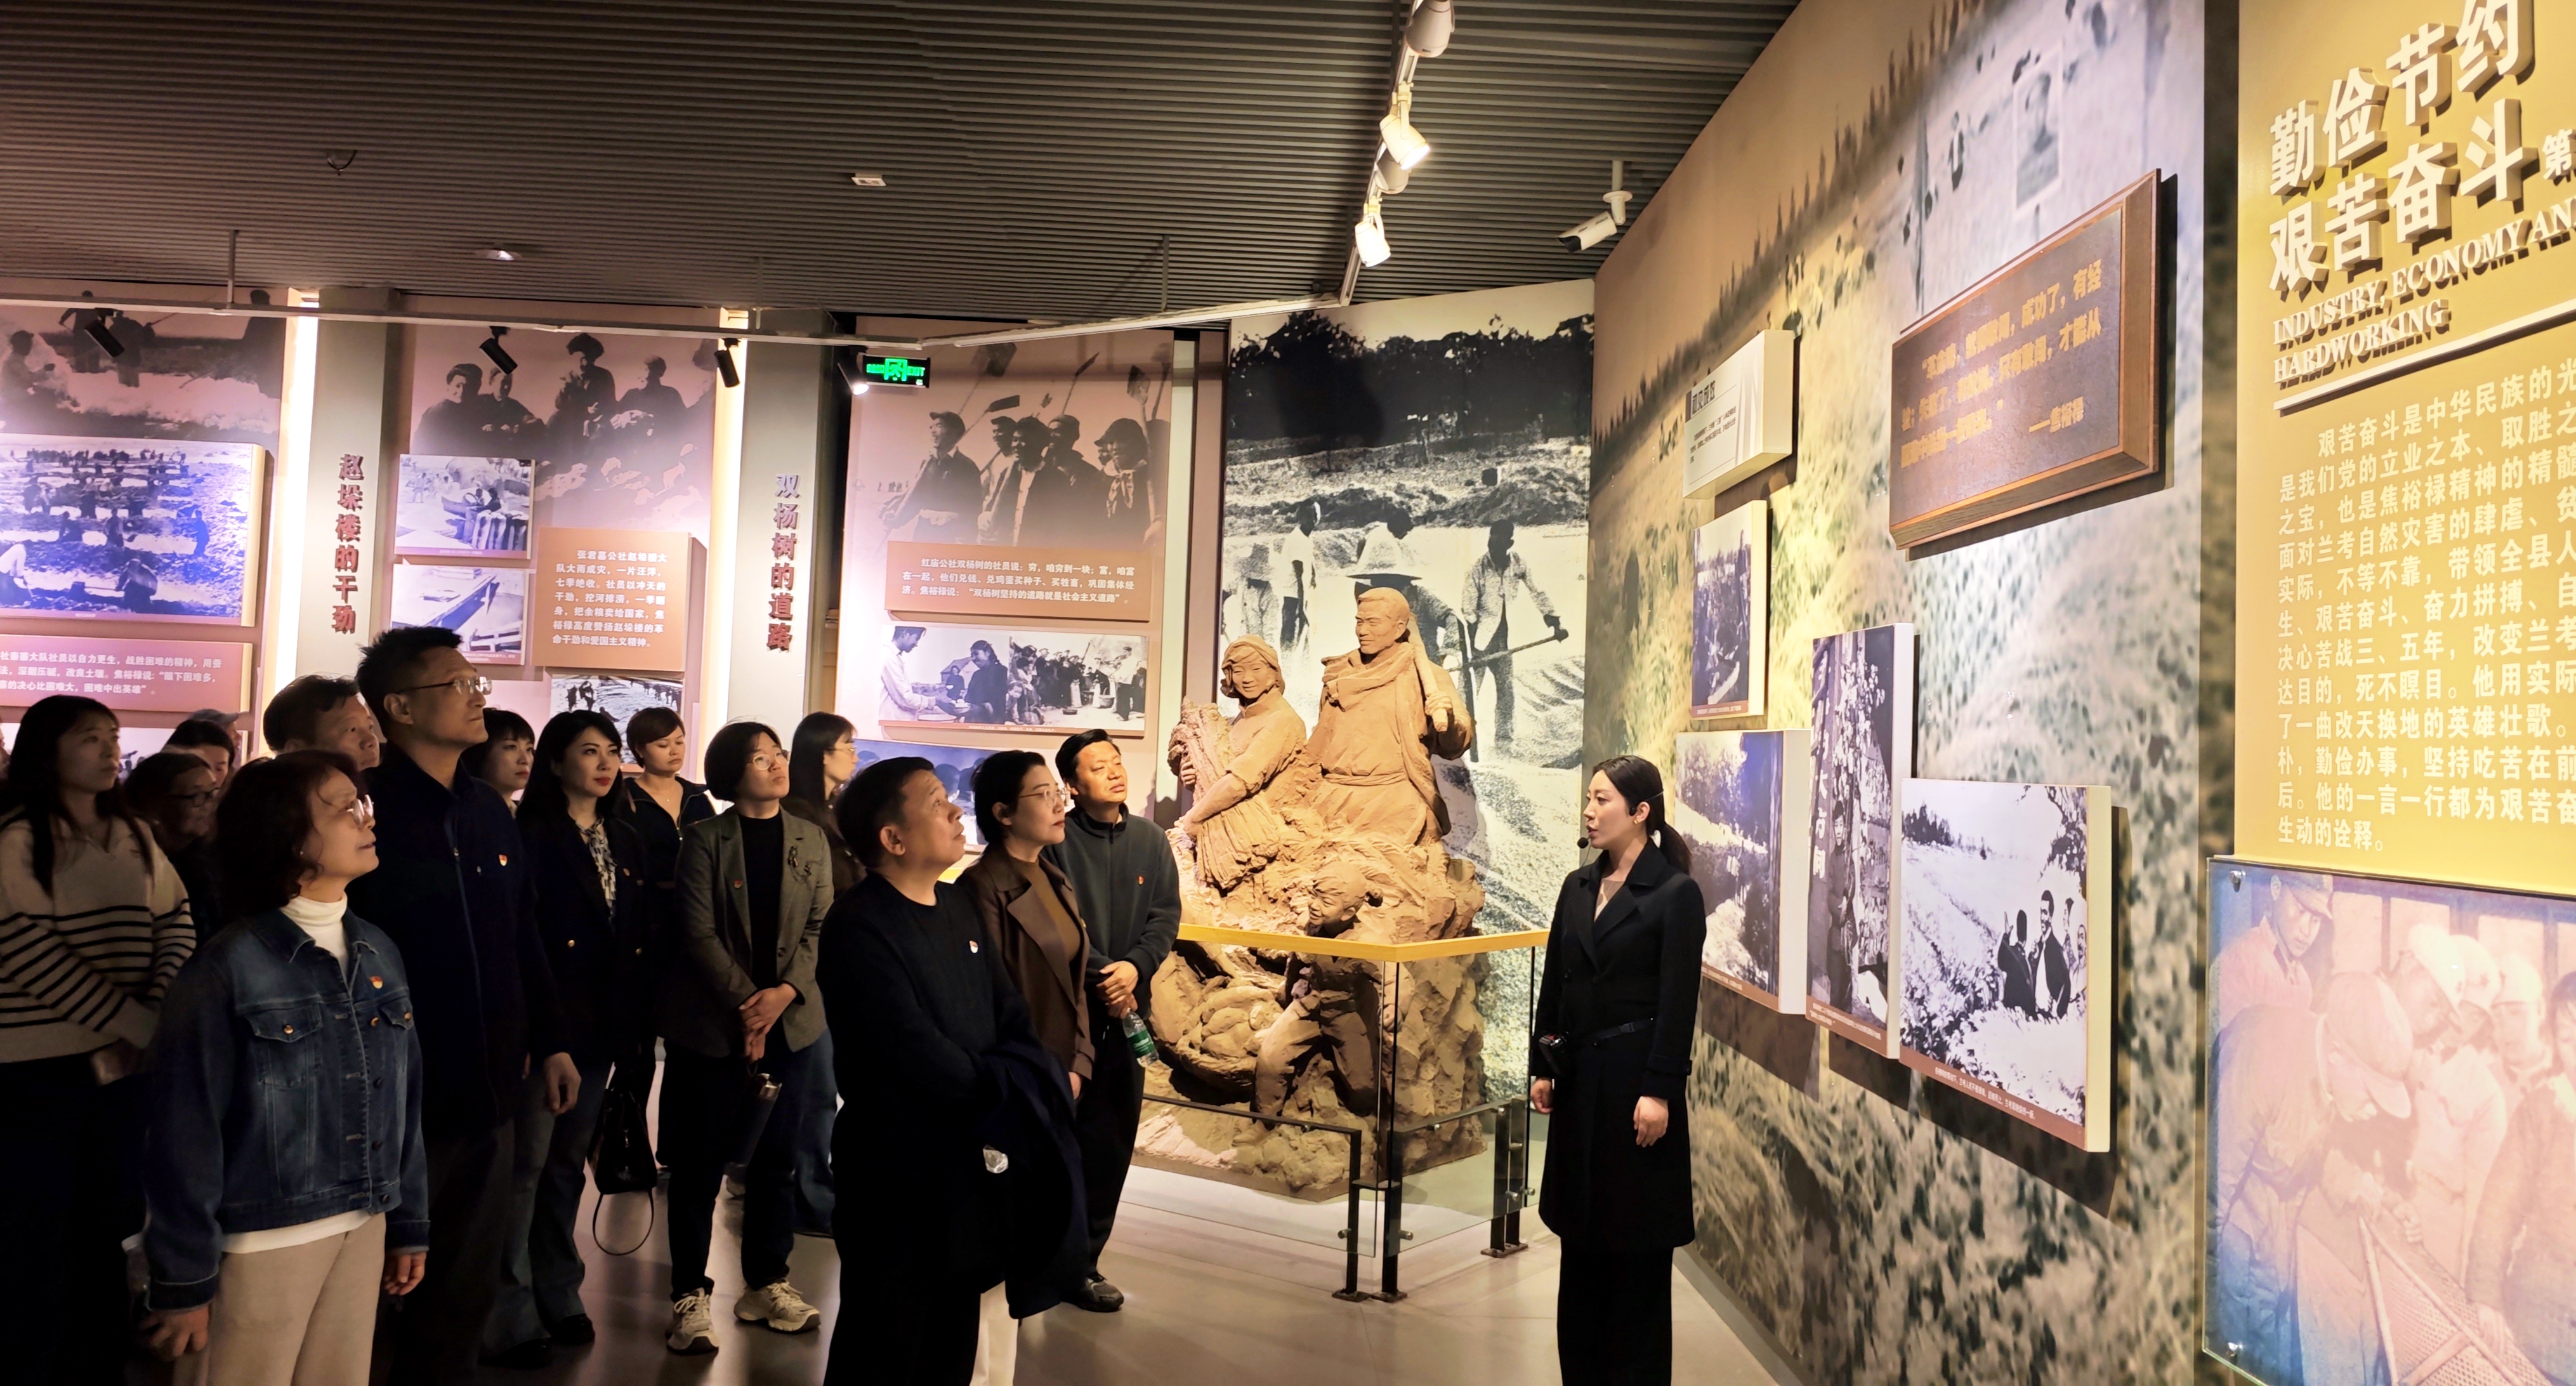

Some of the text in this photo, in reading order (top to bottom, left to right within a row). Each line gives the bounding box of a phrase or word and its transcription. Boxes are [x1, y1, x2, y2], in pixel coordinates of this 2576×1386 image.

[2270, 0, 2530, 197] 勤俭节约
[2542, 129, 2576, 181] 第
[2269, 98, 2533, 292] 艰苦奋斗
[2273, 195, 2576, 345] INDUSTRY, ECONOMY AN
[2273, 300, 2447, 384] HARDWORKING
[907, 366, 925, 376] EXIT
[2318, 358, 2576, 458] 艰苦奋斗是中华民族的光
[2279, 400, 2576, 503] 是我们党的立业之本、取胜之
[2278, 442, 2576, 535] 之宝，也是焦裕禄精神的精髓
[331, 453, 365, 635] 赵垛楼的干劲
[2279, 485, 2576, 570] 面对兰考自然灾害的肆虐、贫
[556, 563, 662, 576] 队大雨成灾，一片汪洋，
[577, 550, 667, 563] 张君墓公社赵垛楼大
[766, 473, 800, 652] 双杨树的道路
[902, 571, 1134, 590] 在一起，他们兑钱、兑鸡蛋买种子、买牲畜，巩固集体经
[2278, 530, 2576, 604] 实际，不等不靠，带领全县人
[555, 578, 666, 591] 七季绝收。社员以冲天的
[2278, 572, 2576, 637] 生、艰苦奋斗、奋力拼搏、自
[553, 620, 664, 633] 裕禄高度赞扬赵垛楼的革
[554, 606, 665, 619] 身，把余粮卖给国家，焦
[552, 634, 651, 647] 命干劲和爱国主义精神。
[2278, 615, 2576, 671] 决心苦战三、五年，改变兰考
[2278, 660, 2576, 704] 达目的，死不瞑目。他用实际
[2278, 703, 2566, 740] 了一曲改天换地的英雄壮歌。
[2278, 745, 2576, 781] 朴，勤俭办事，坚持吃苦在前
[2278, 781, 2576, 825] 后。他的一言一行都为艰苦奋
[2278, 815, 2383, 852] 生动的诠释。
